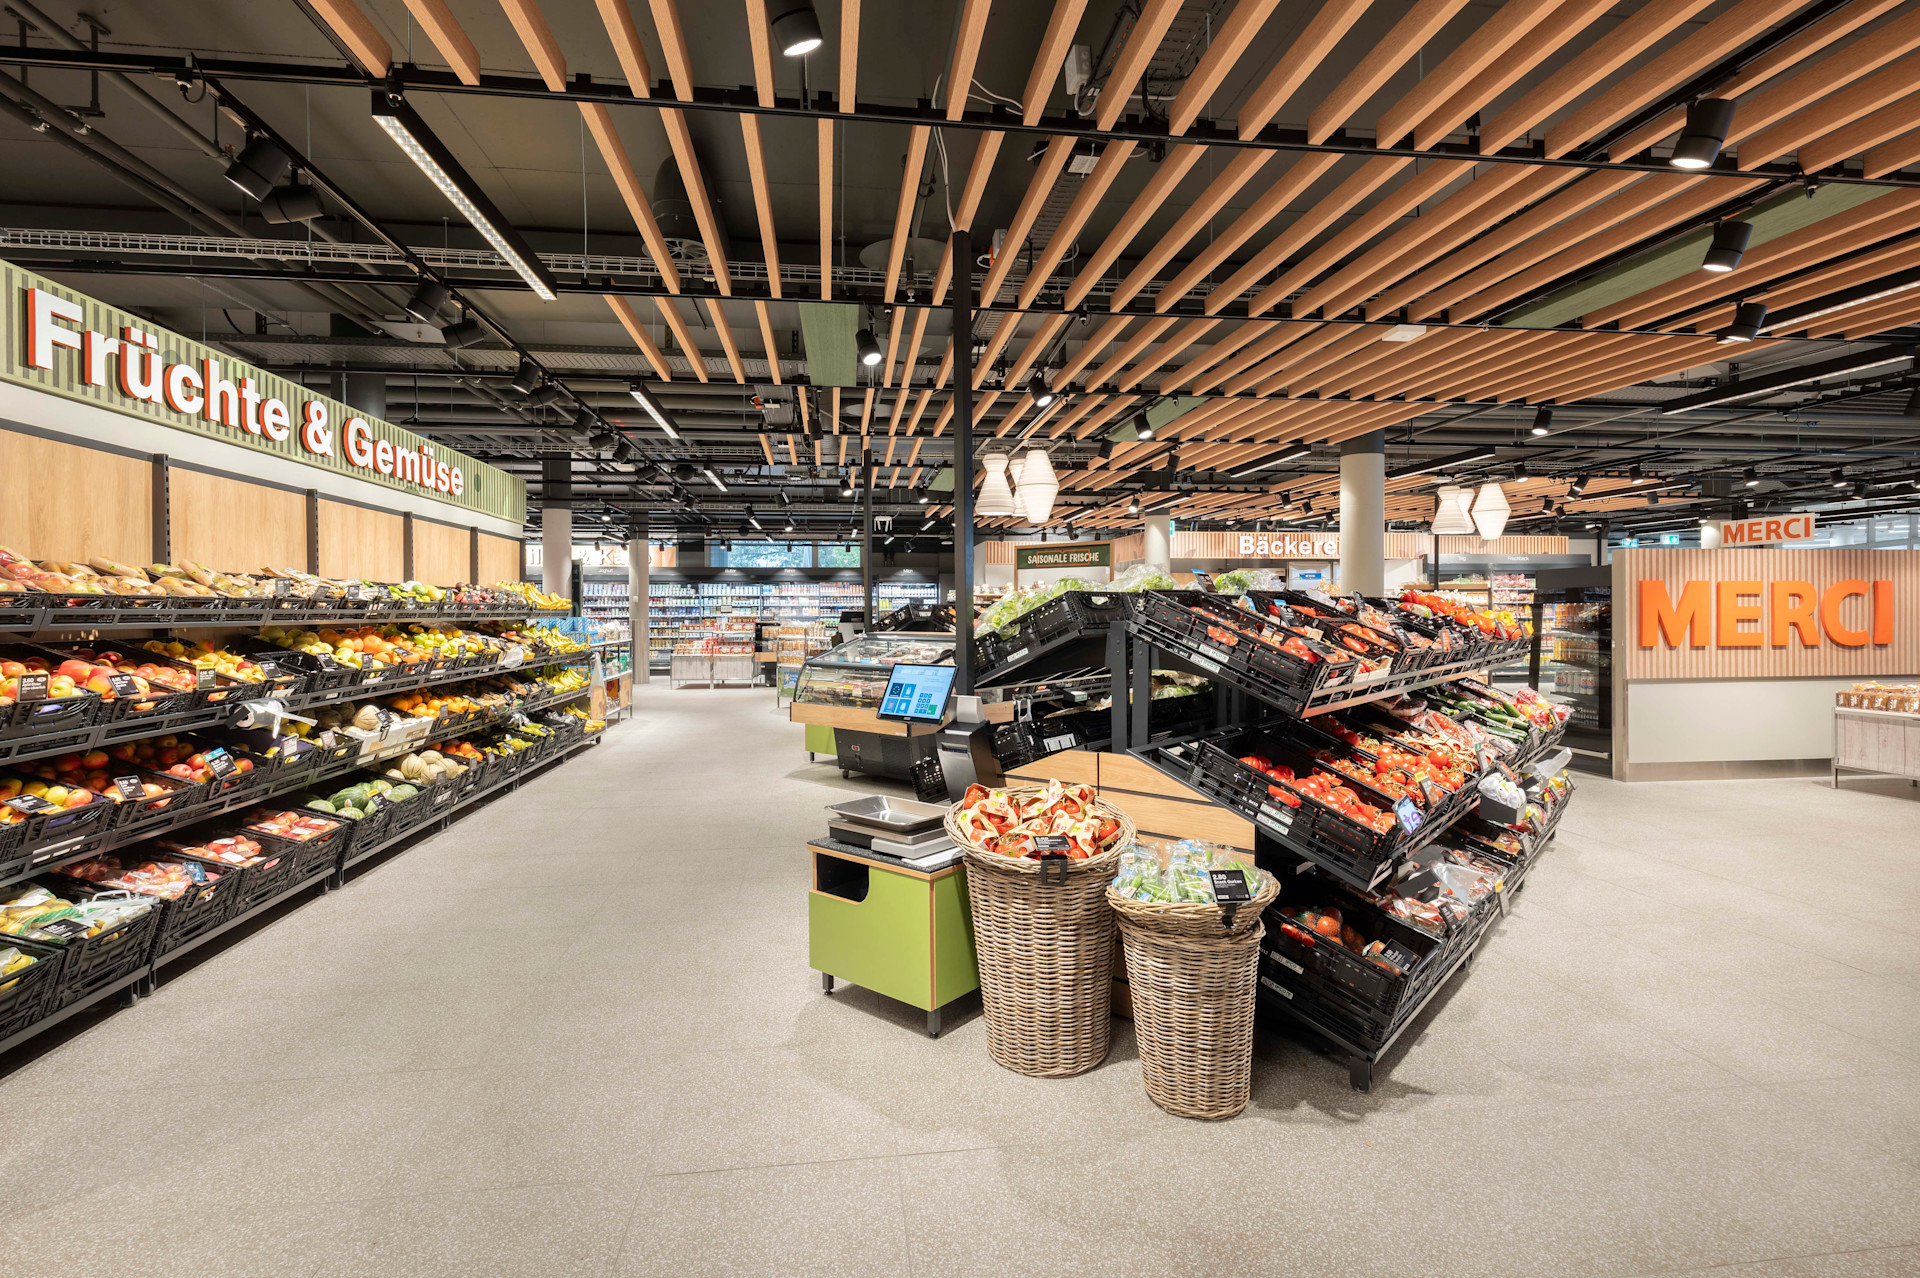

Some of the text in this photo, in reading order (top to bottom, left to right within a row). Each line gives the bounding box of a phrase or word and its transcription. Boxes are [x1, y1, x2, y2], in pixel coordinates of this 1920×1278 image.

[28, 287, 464, 496] Früchte & Gemüse
[1723, 517, 1811, 544] MERCI
[1027, 552, 1100, 564] SAISONALE FRISCHE
[1639, 578, 1894, 647] MERCI
